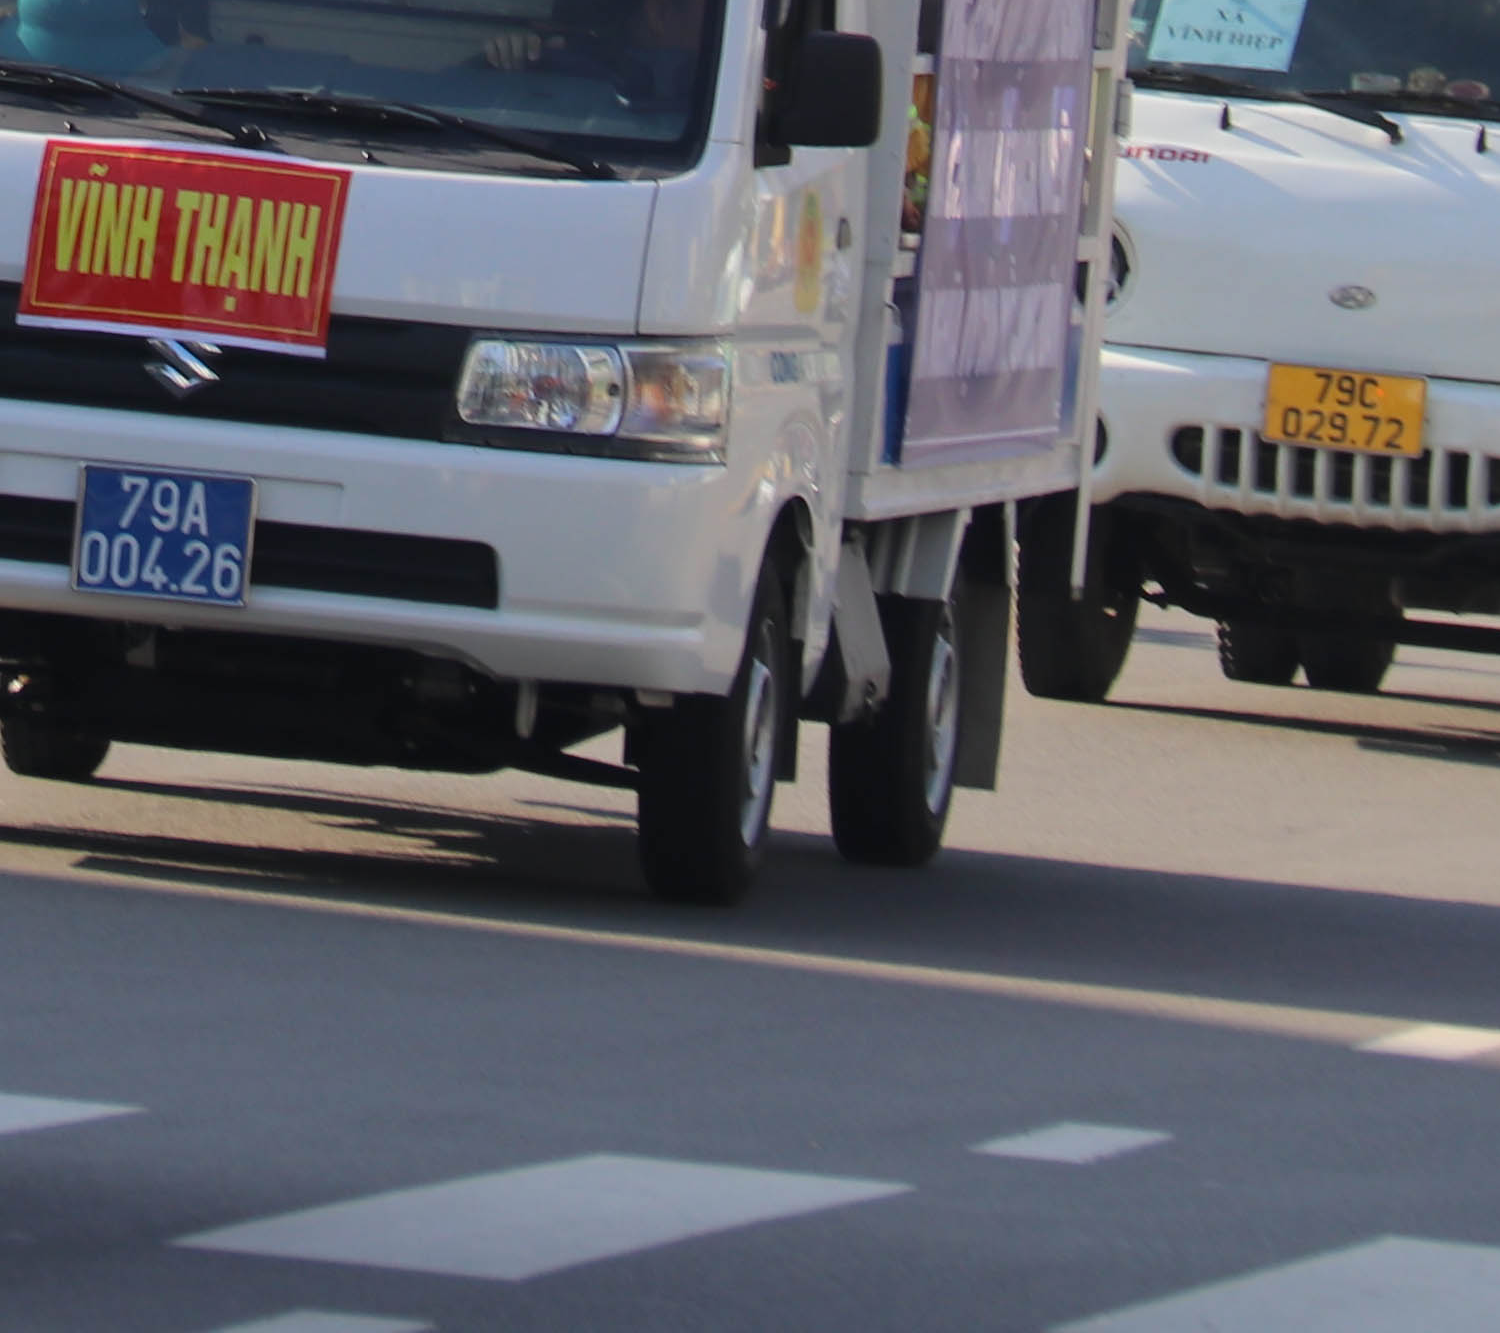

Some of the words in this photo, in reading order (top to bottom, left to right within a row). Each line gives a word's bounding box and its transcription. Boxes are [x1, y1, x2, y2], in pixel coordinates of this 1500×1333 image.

[54, 162, 165, 280] VĨNH
[170, 188, 322, 312] THẠNH
[1314, 373, 1379, 409] 79C
[1282, 406, 1404, 450] 029.72
[119, 474, 210, 537] 79A
[79, 530, 243, 597] 004.26
